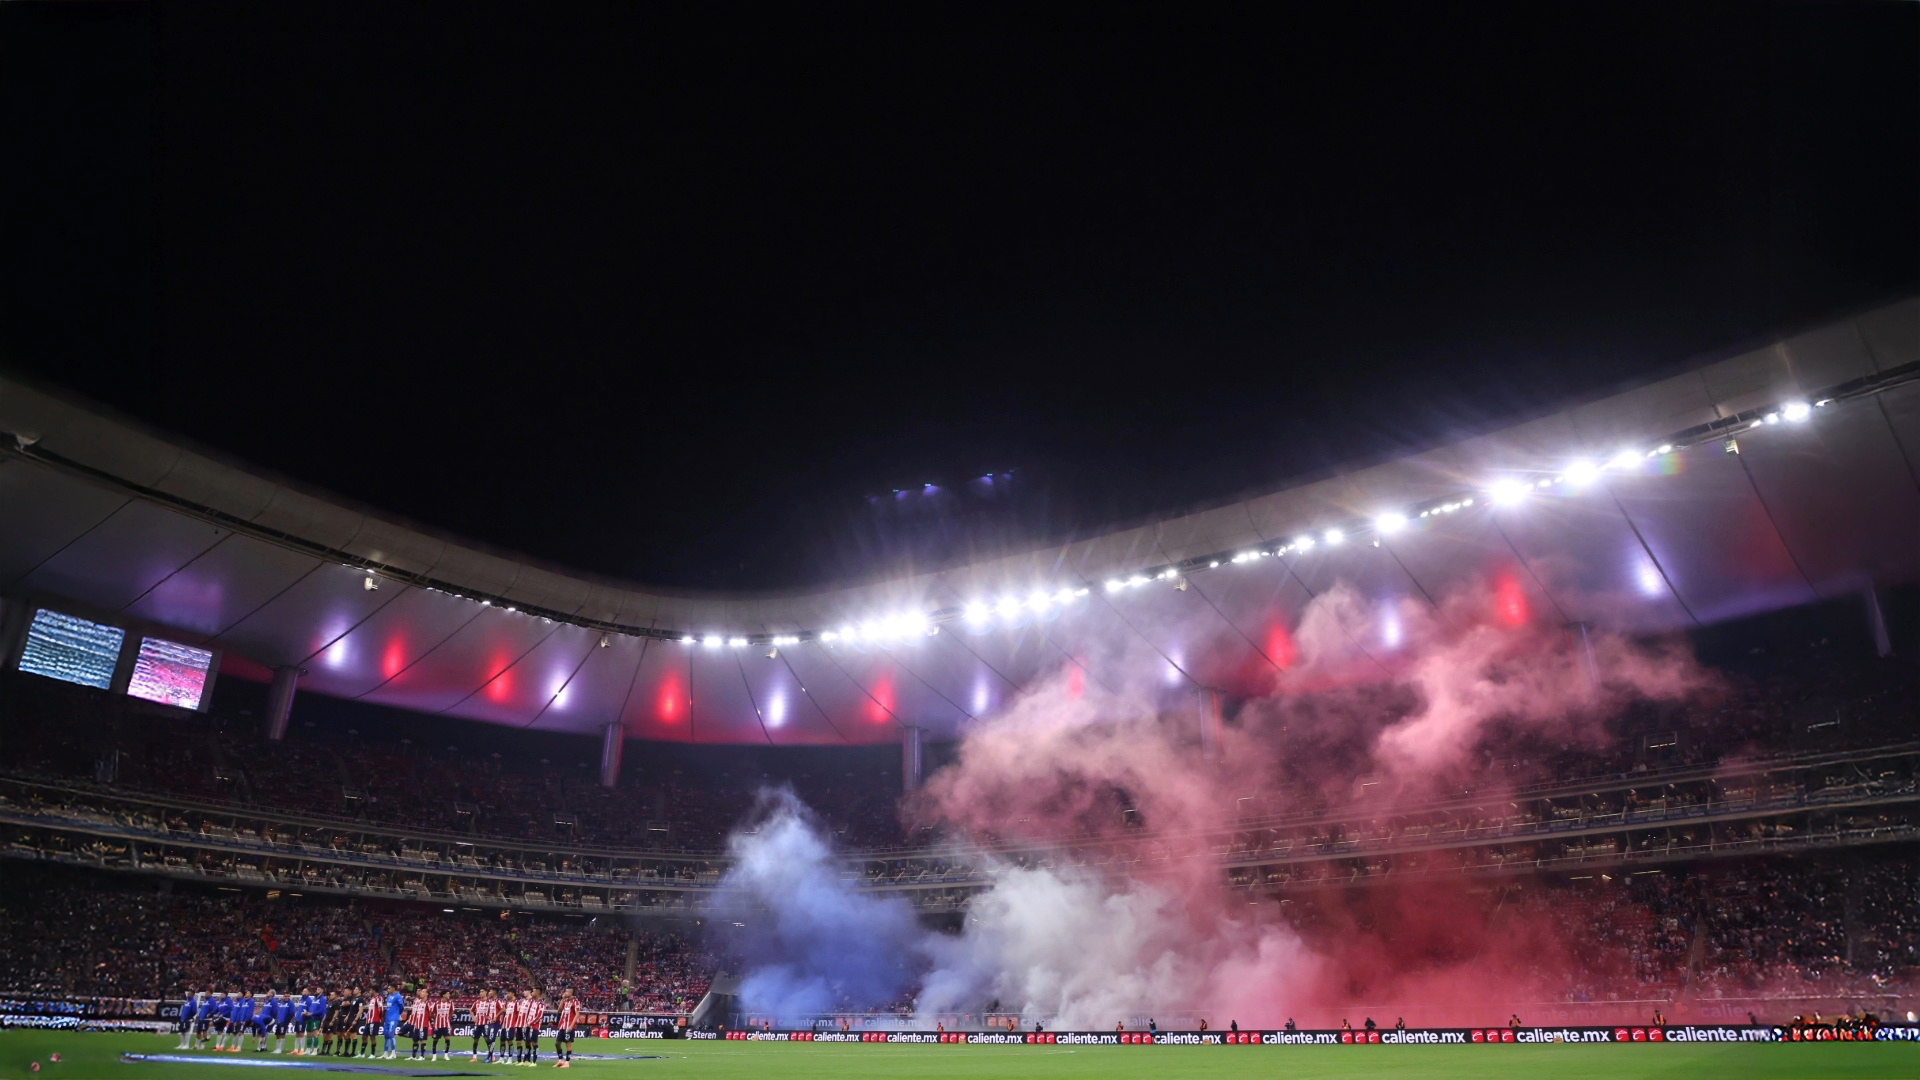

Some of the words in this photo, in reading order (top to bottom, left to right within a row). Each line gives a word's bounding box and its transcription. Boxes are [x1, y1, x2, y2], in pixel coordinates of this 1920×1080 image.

[610, 1016, 675, 1026] calientemx
[609, 1028, 663, 1039] caliente.mx
[693, 1030, 717, 1039] Steren
[747, 1031, 790, 1041] caliente.mx
[814, 1032, 860, 1042] caliente.mx
[888, 1032, 938, 1043] caliente.mx
[968, 1033, 1023, 1044] caliente.mx
[1057, 1033, 1118, 1044] caliente.mx
[1154, 1032, 1221, 1044] caliente.mx
[1263, 1031, 1338, 1044] caliente.mx
[1382, 1030, 1466, 1043] caliente.mx
[1517, 1029, 1611, 1042] caliente.mx
